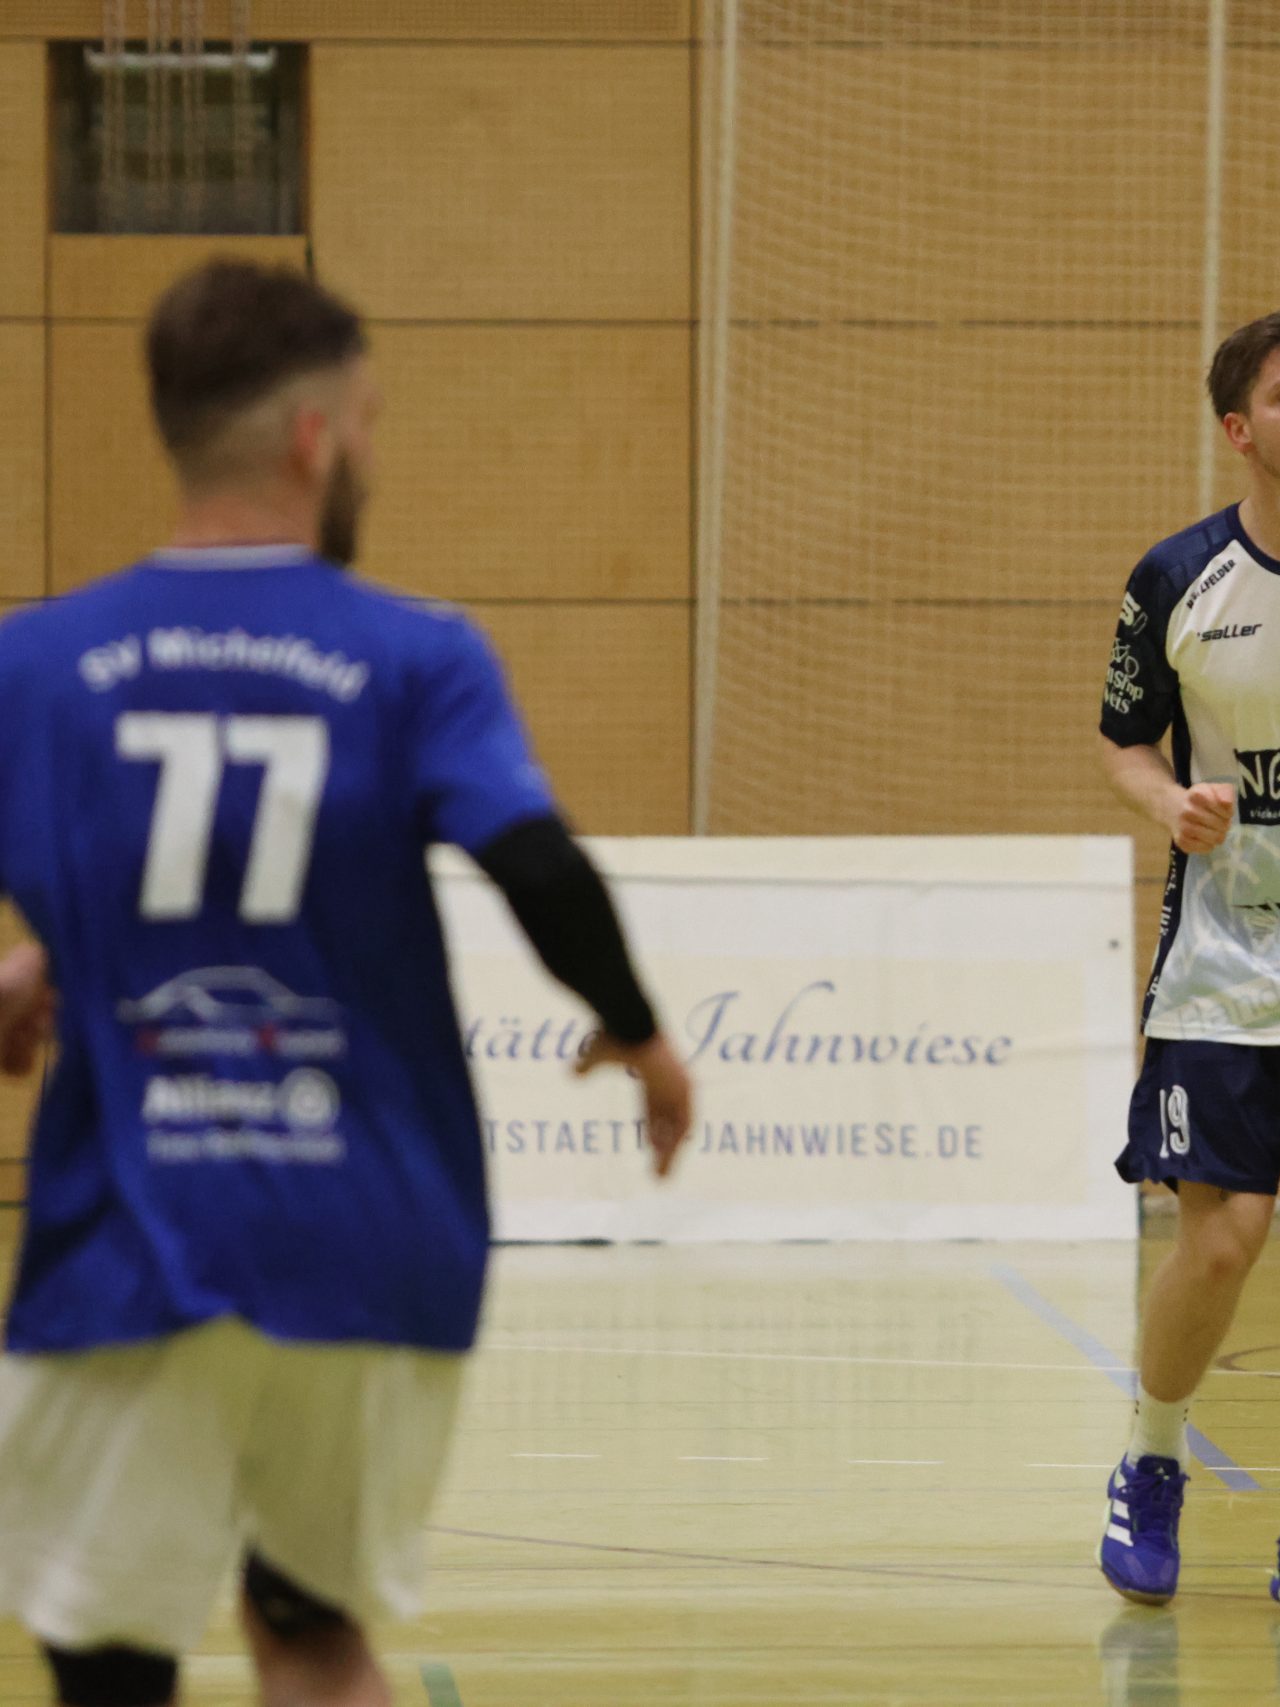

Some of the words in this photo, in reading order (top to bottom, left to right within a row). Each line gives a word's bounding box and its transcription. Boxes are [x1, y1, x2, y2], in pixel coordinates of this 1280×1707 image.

[115, 710, 330, 924] 77
[684, 980, 1014, 1067] Jahnwiese
[1160, 1084, 1191, 1159] 19
